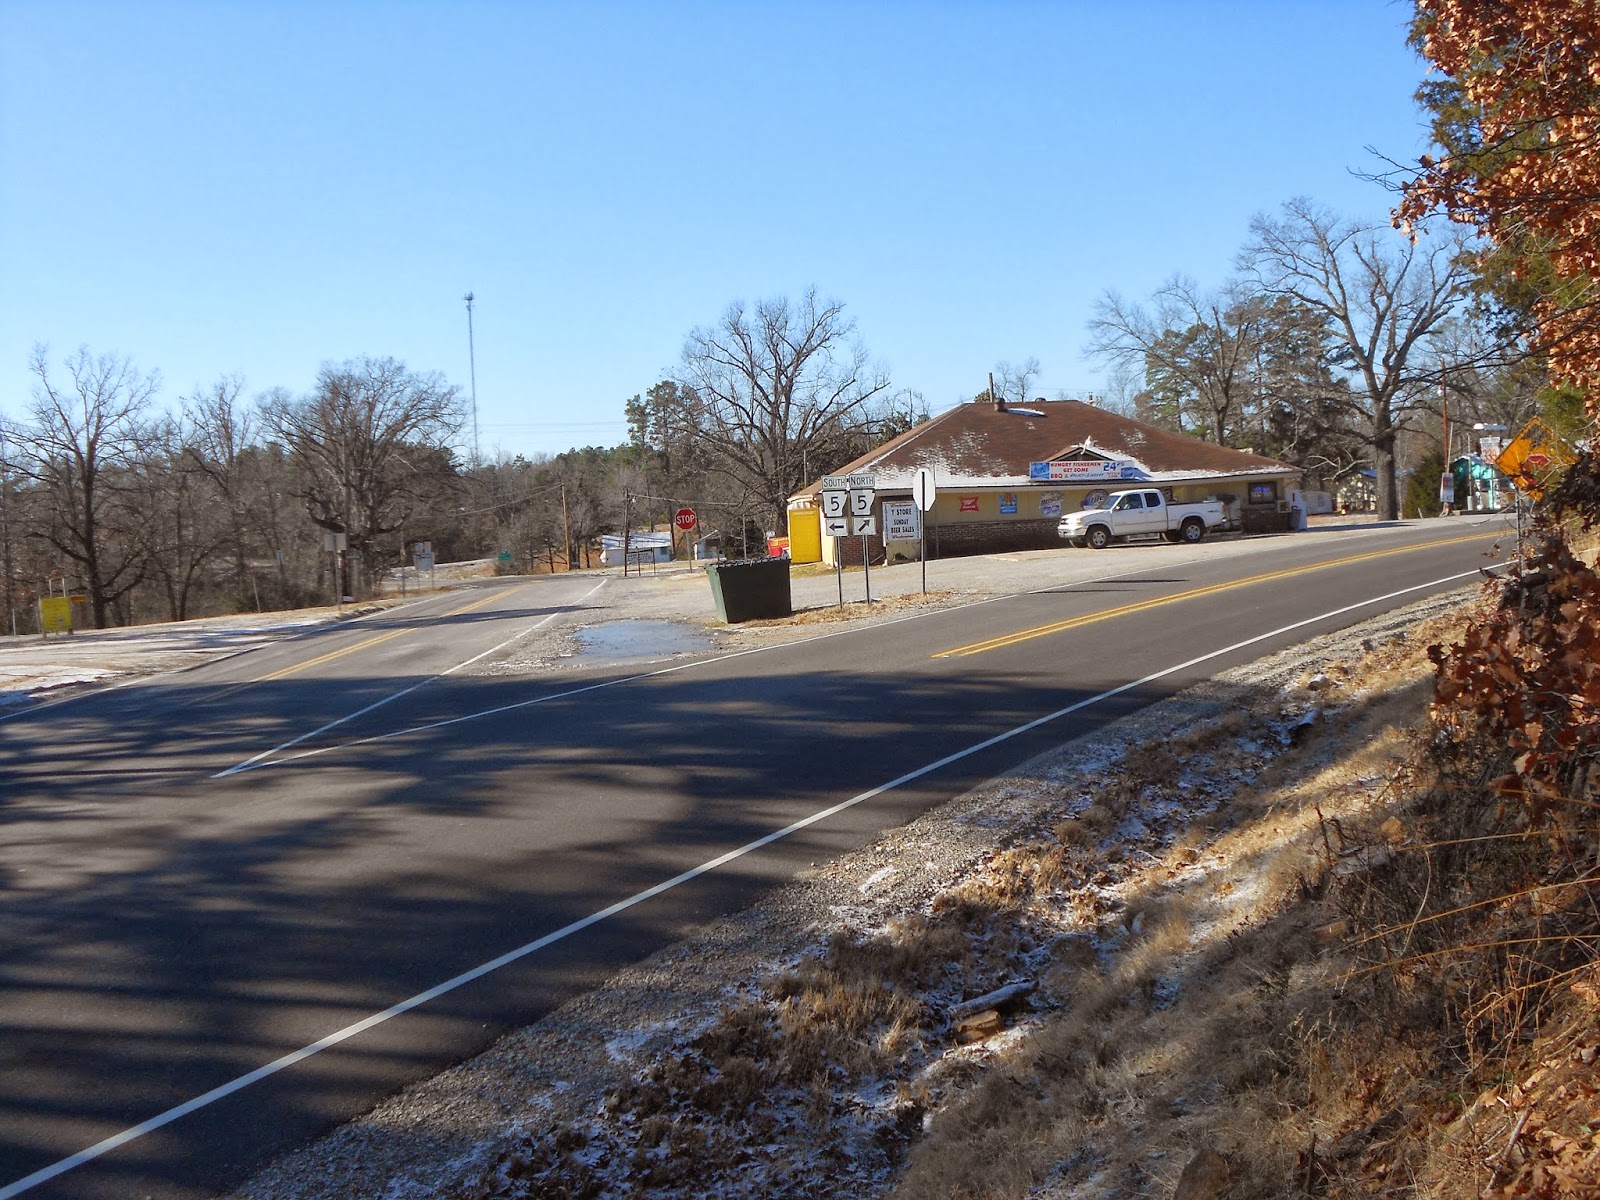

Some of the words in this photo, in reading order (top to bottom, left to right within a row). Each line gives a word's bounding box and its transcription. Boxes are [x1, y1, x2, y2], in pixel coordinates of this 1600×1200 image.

[823, 477, 845, 487] SOUTH
[850, 476, 873, 486] NORTH
[830, 496, 840, 511] 5
[858, 495, 867, 510] 5
[896, 508, 912, 516] STORE
[676, 514, 695, 525] STOP
